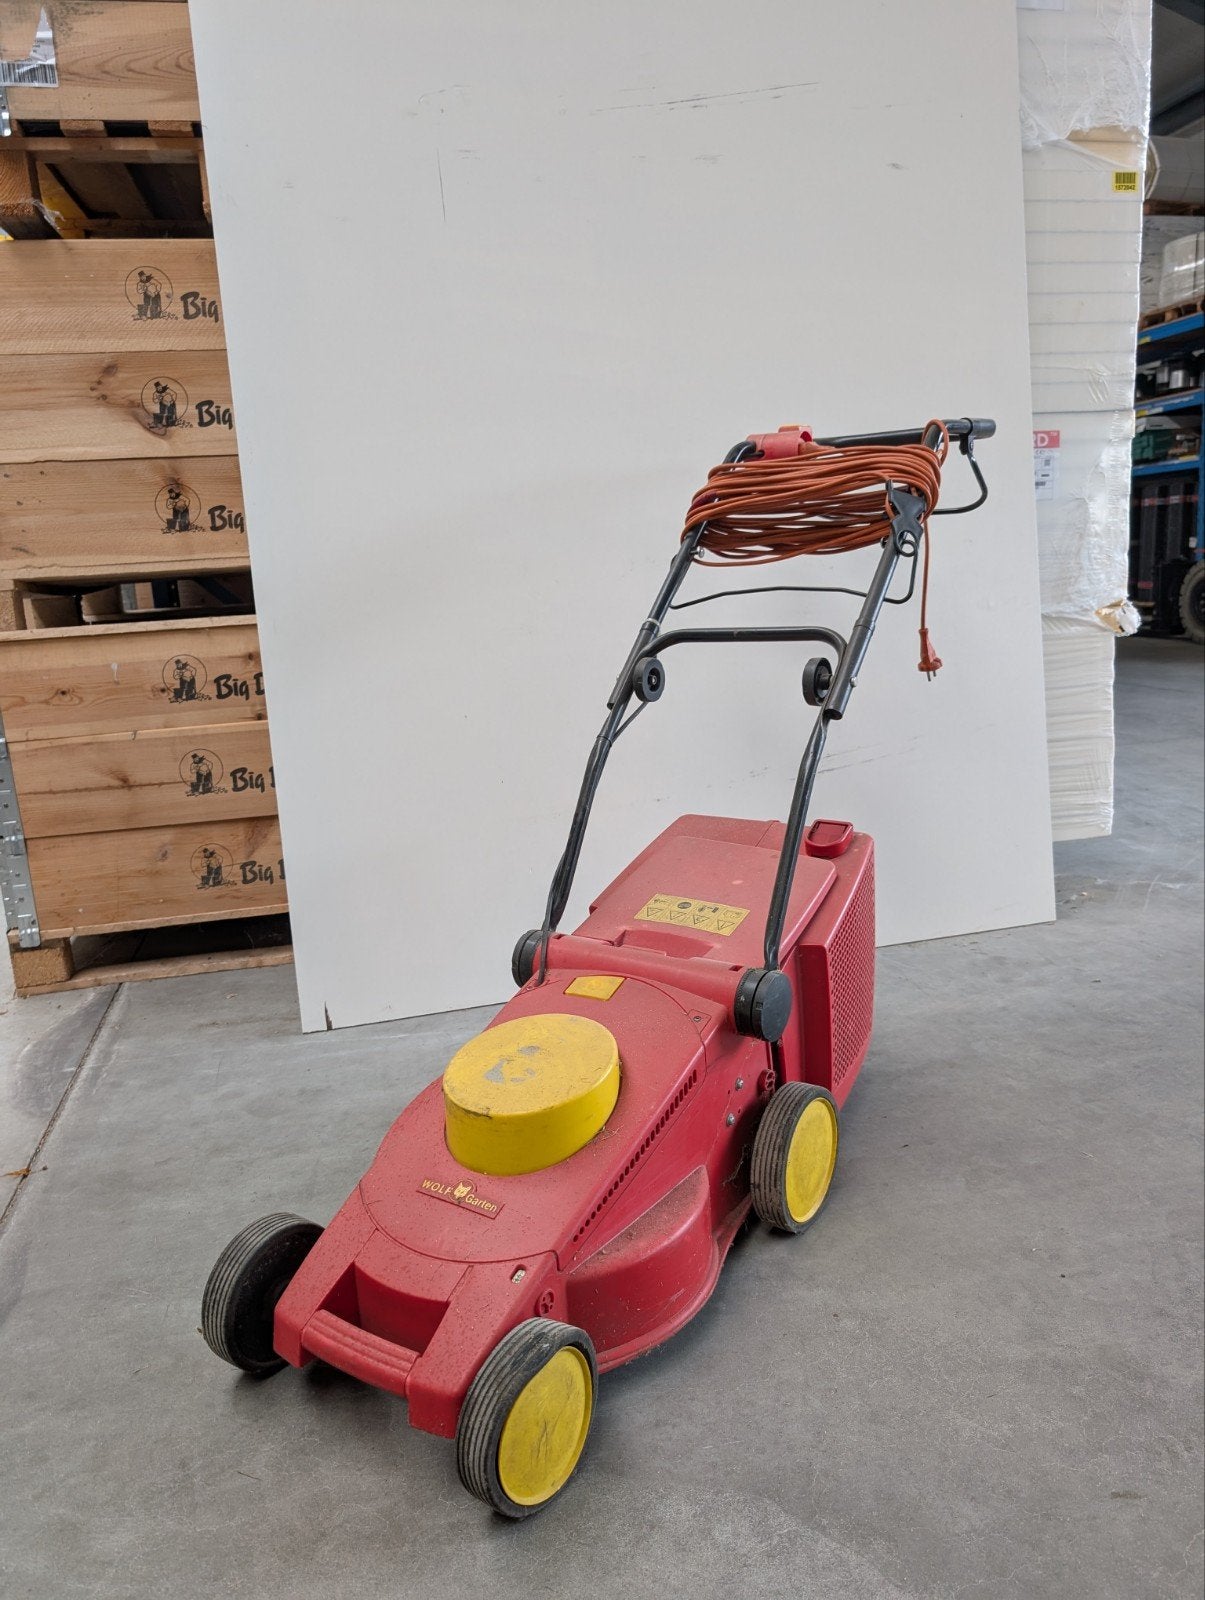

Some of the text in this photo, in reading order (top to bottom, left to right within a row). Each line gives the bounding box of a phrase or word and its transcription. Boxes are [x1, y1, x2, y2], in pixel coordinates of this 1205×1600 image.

[180, 291, 219, 323] Big
[195, 400, 233, 430] Big
[208, 505, 245, 534] Big
[214, 674, 249, 701] Big
[230, 767, 265, 793] Big
[240, 860, 274, 885] Big
[421, 1179, 498, 1213] WOLF Garten
